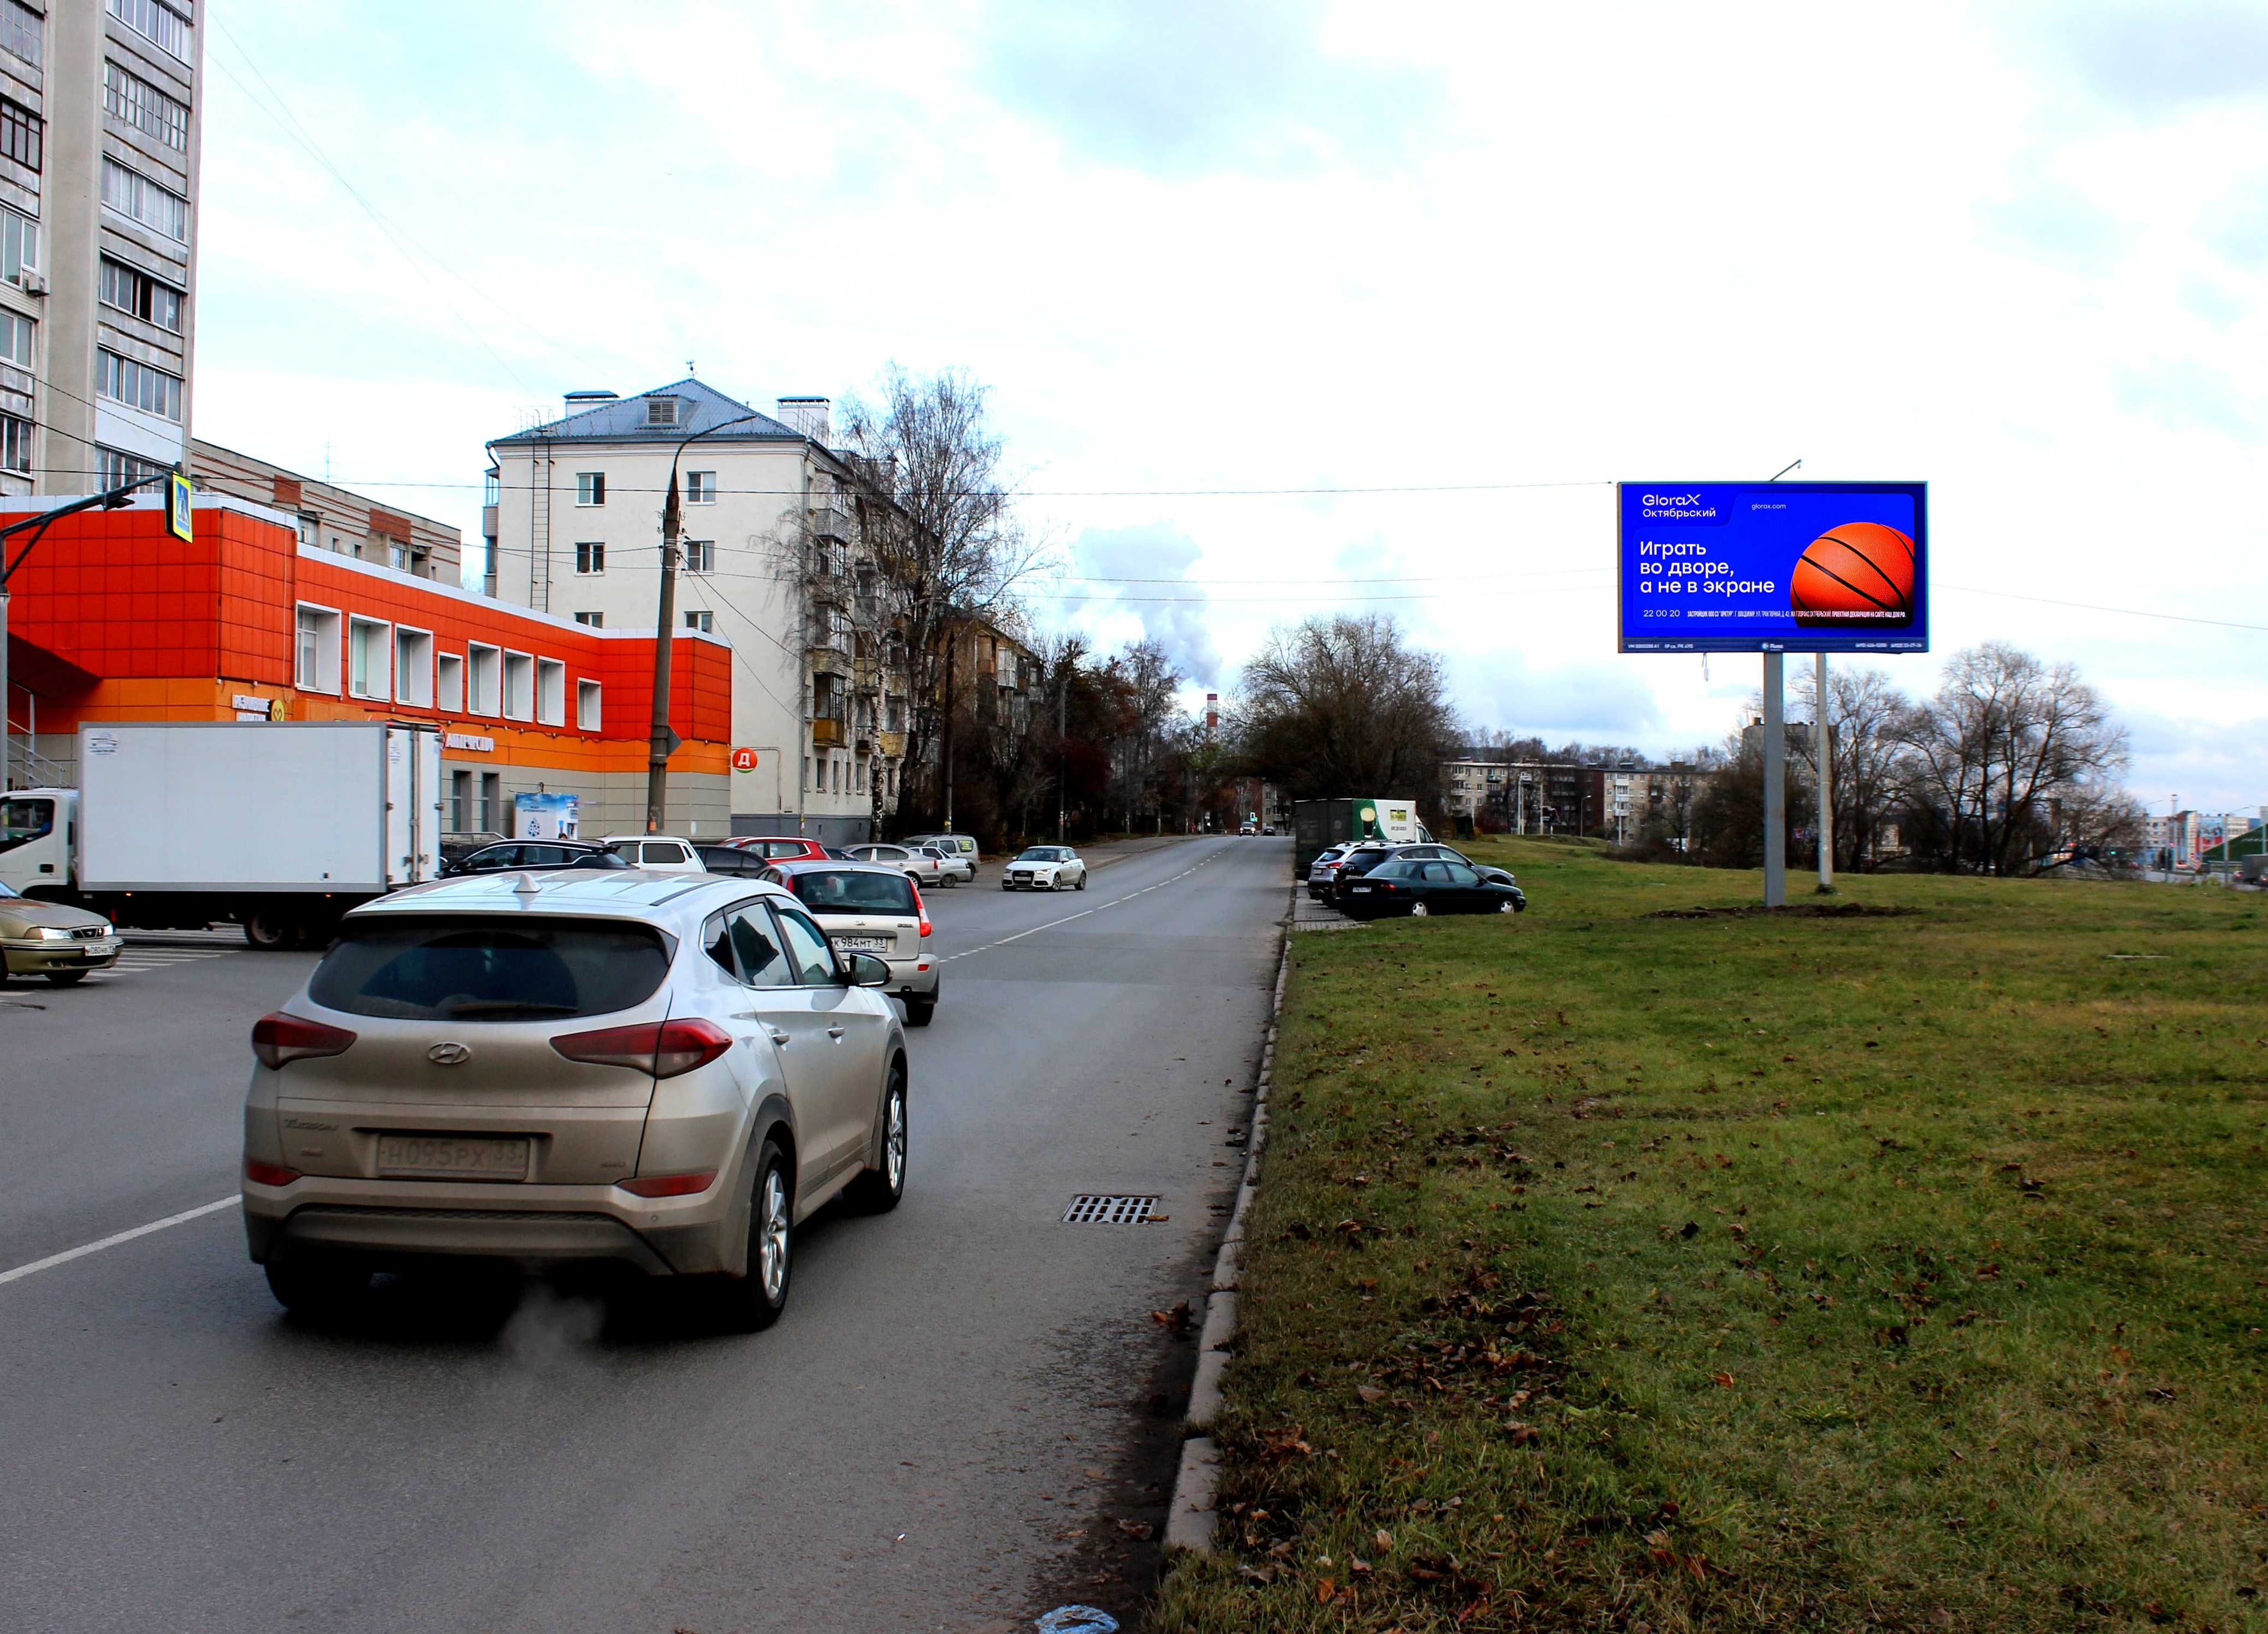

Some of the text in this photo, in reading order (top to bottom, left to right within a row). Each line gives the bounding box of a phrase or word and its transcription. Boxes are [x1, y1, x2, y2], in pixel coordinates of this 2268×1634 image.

[1643, 494, 1701, 506] GloraX
[1643, 507, 1716, 519] Октябрьский
[1640, 541, 1706, 560] Играть
[1640, 562, 1734, 579] во дворе,
[1640, 581, 1775, 598] а не в экране
[738, 753, 750, 767] Д
[493, 1140, 517, 1161] 33
